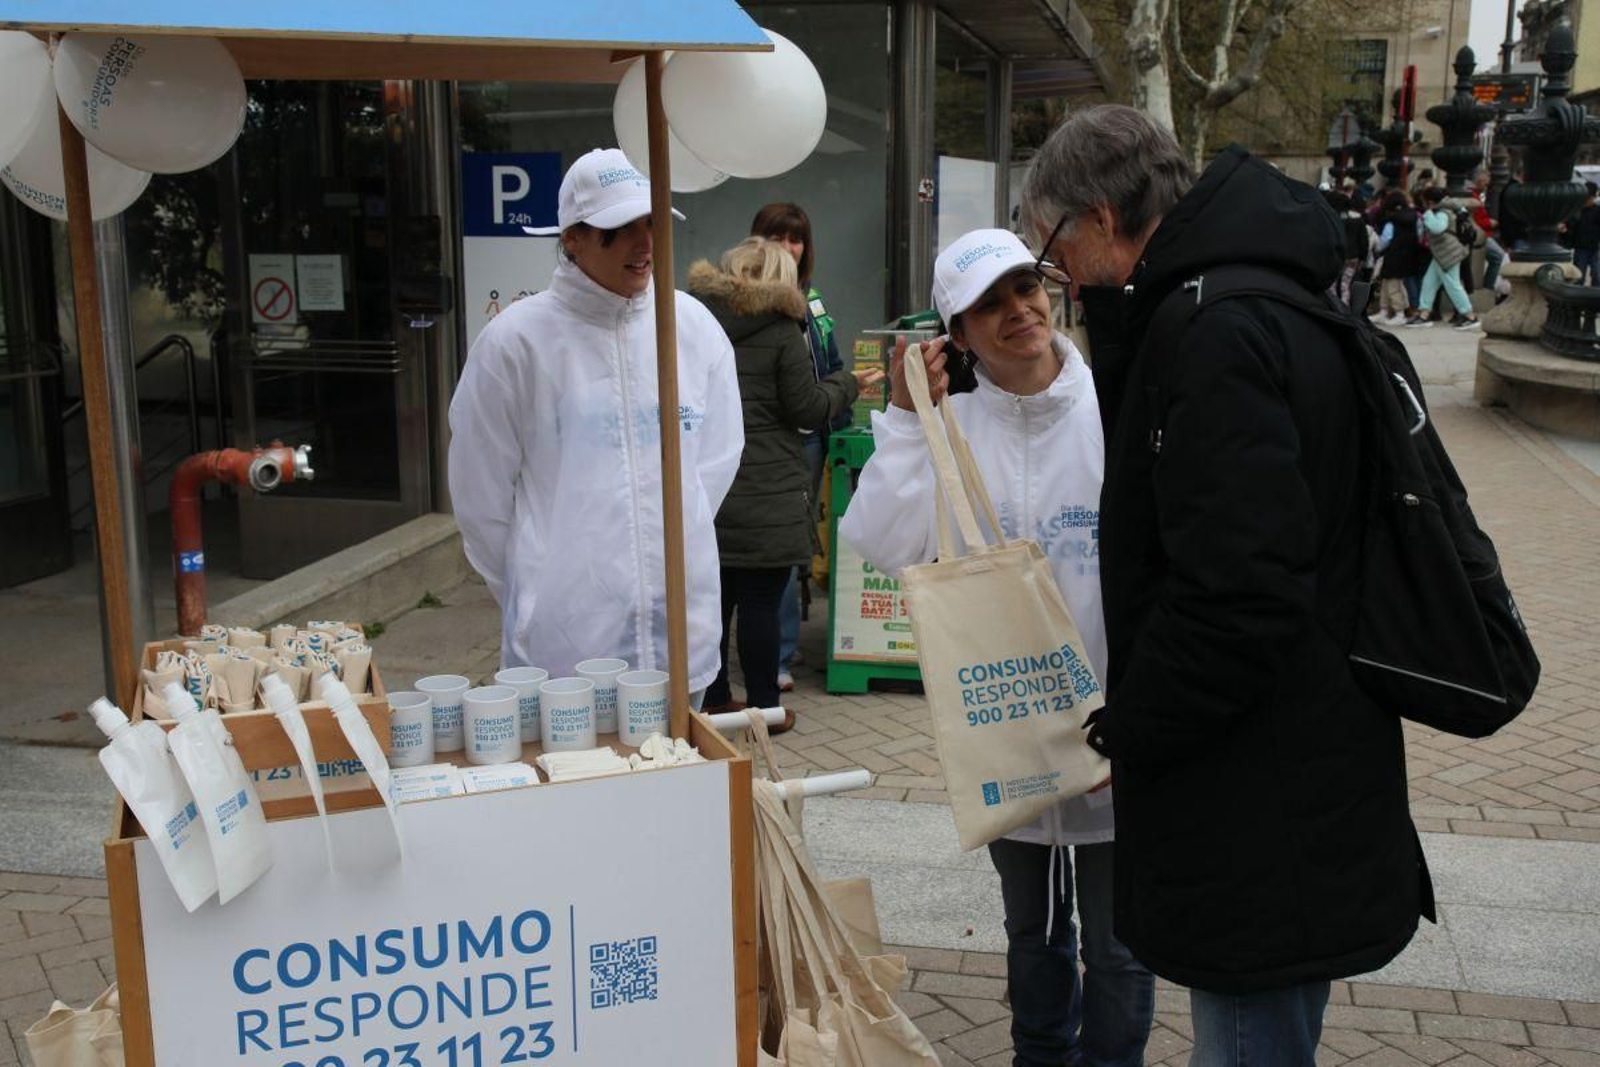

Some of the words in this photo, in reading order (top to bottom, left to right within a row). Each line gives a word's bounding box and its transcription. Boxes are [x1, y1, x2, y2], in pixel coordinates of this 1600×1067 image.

[100, 41, 136, 107] PERSOAS
[492, 165, 531, 225] P
[508, 213, 532, 225] 24h
[1061, 511, 1100, 521] PERSOA
[870, 600, 893, 608] TUA
[958, 651, 1064, 685] CONSUMO
[962, 672, 1070, 707] RESPONDE
[474, 715, 514, 726] CONSUMO
[550, 706, 590, 717] CONSUMO
[967, 707, 1003, 727] 900
[1007, 702, 1029, 720] 23
[1032, 699, 1049, 715] 11
[1052, 694, 1074, 712] 23
[232, 909, 552, 996] CONSUMO
[236, 965, 554, 1055] RESPONDE
[437, 1031, 483, 1067] 11
[500, 1020, 556, 1064] 23
